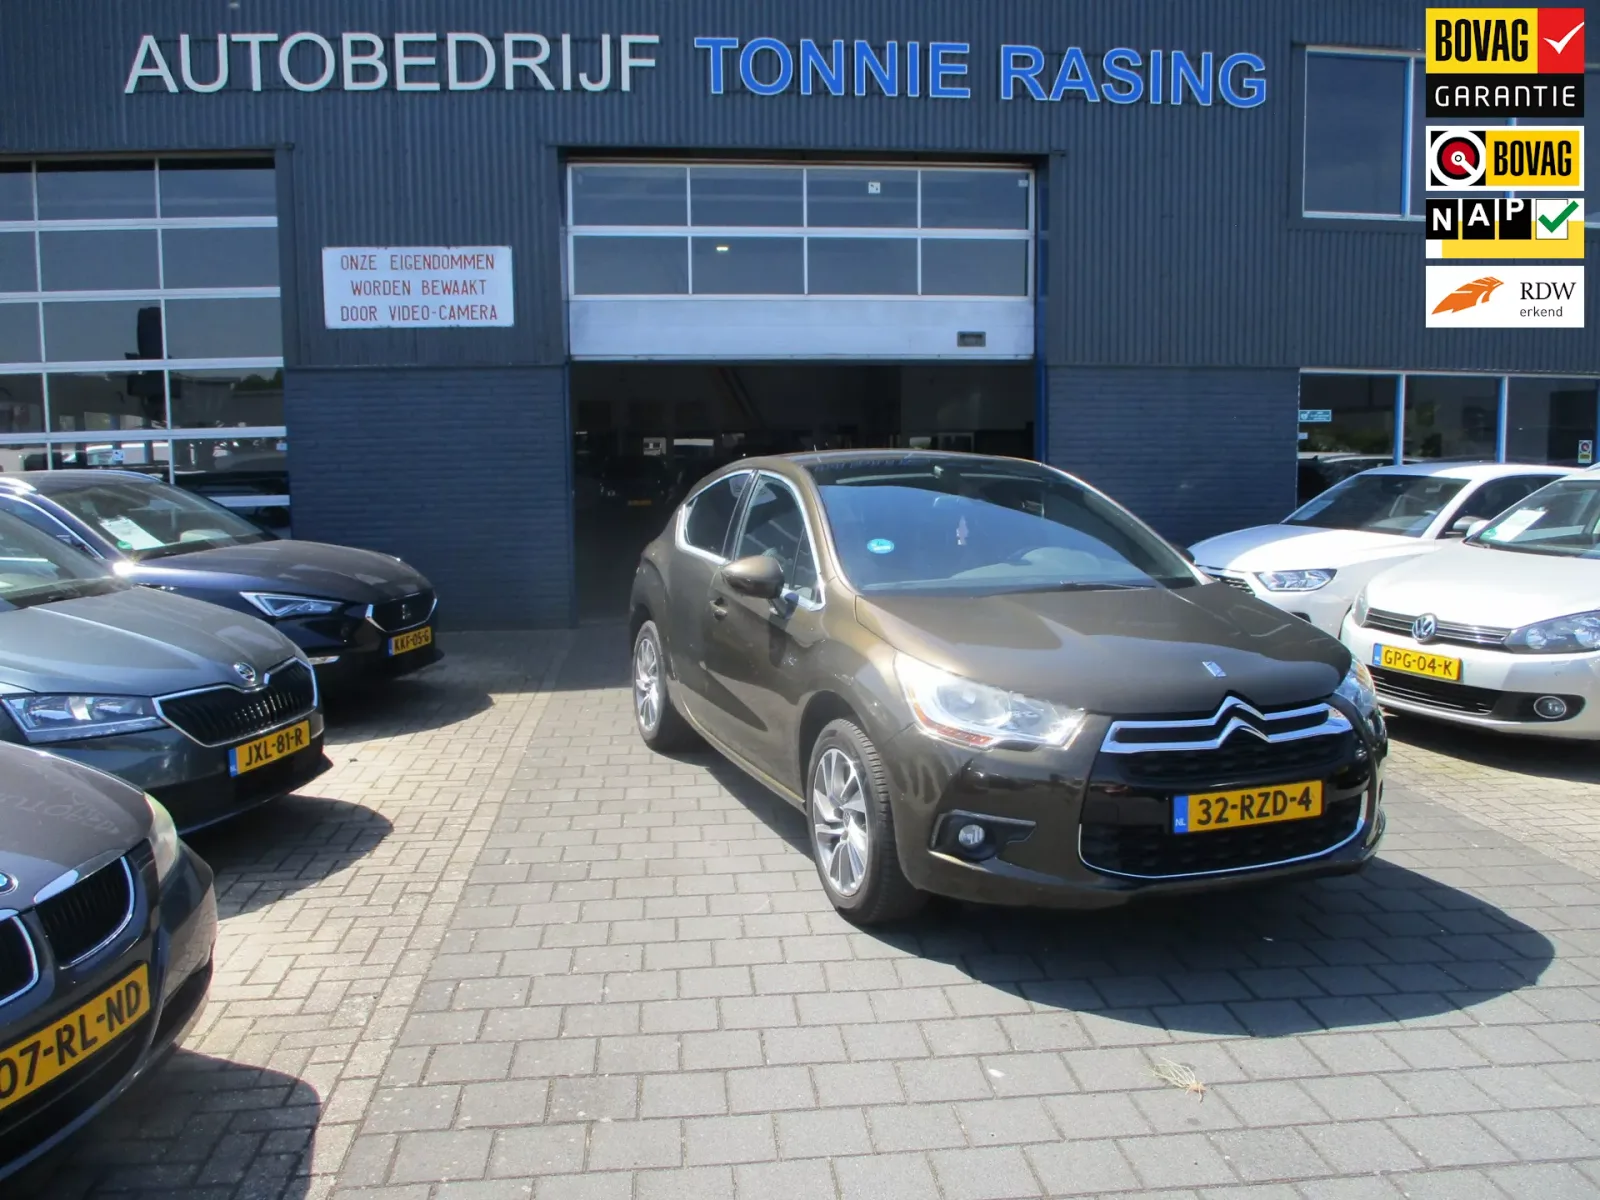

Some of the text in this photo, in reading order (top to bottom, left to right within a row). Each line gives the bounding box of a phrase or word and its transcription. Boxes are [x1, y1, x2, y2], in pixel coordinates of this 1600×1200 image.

[124, 32, 1267, 108] AUTOBEDRIJF TONNIE RASING
[341, 254, 495, 271] ONZE EIGENDOMMEN
[350, 279, 487, 296] WORDEN BEWAAKT
[340, 304, 498, 322] DOOR VIDEO-CAMERA
[1384, 649, 1453, 677] GPG-04-K
[245, 727, 303, 767] JXL-81-R
[1196, 785, 1313, 826] 32-RZD-4
